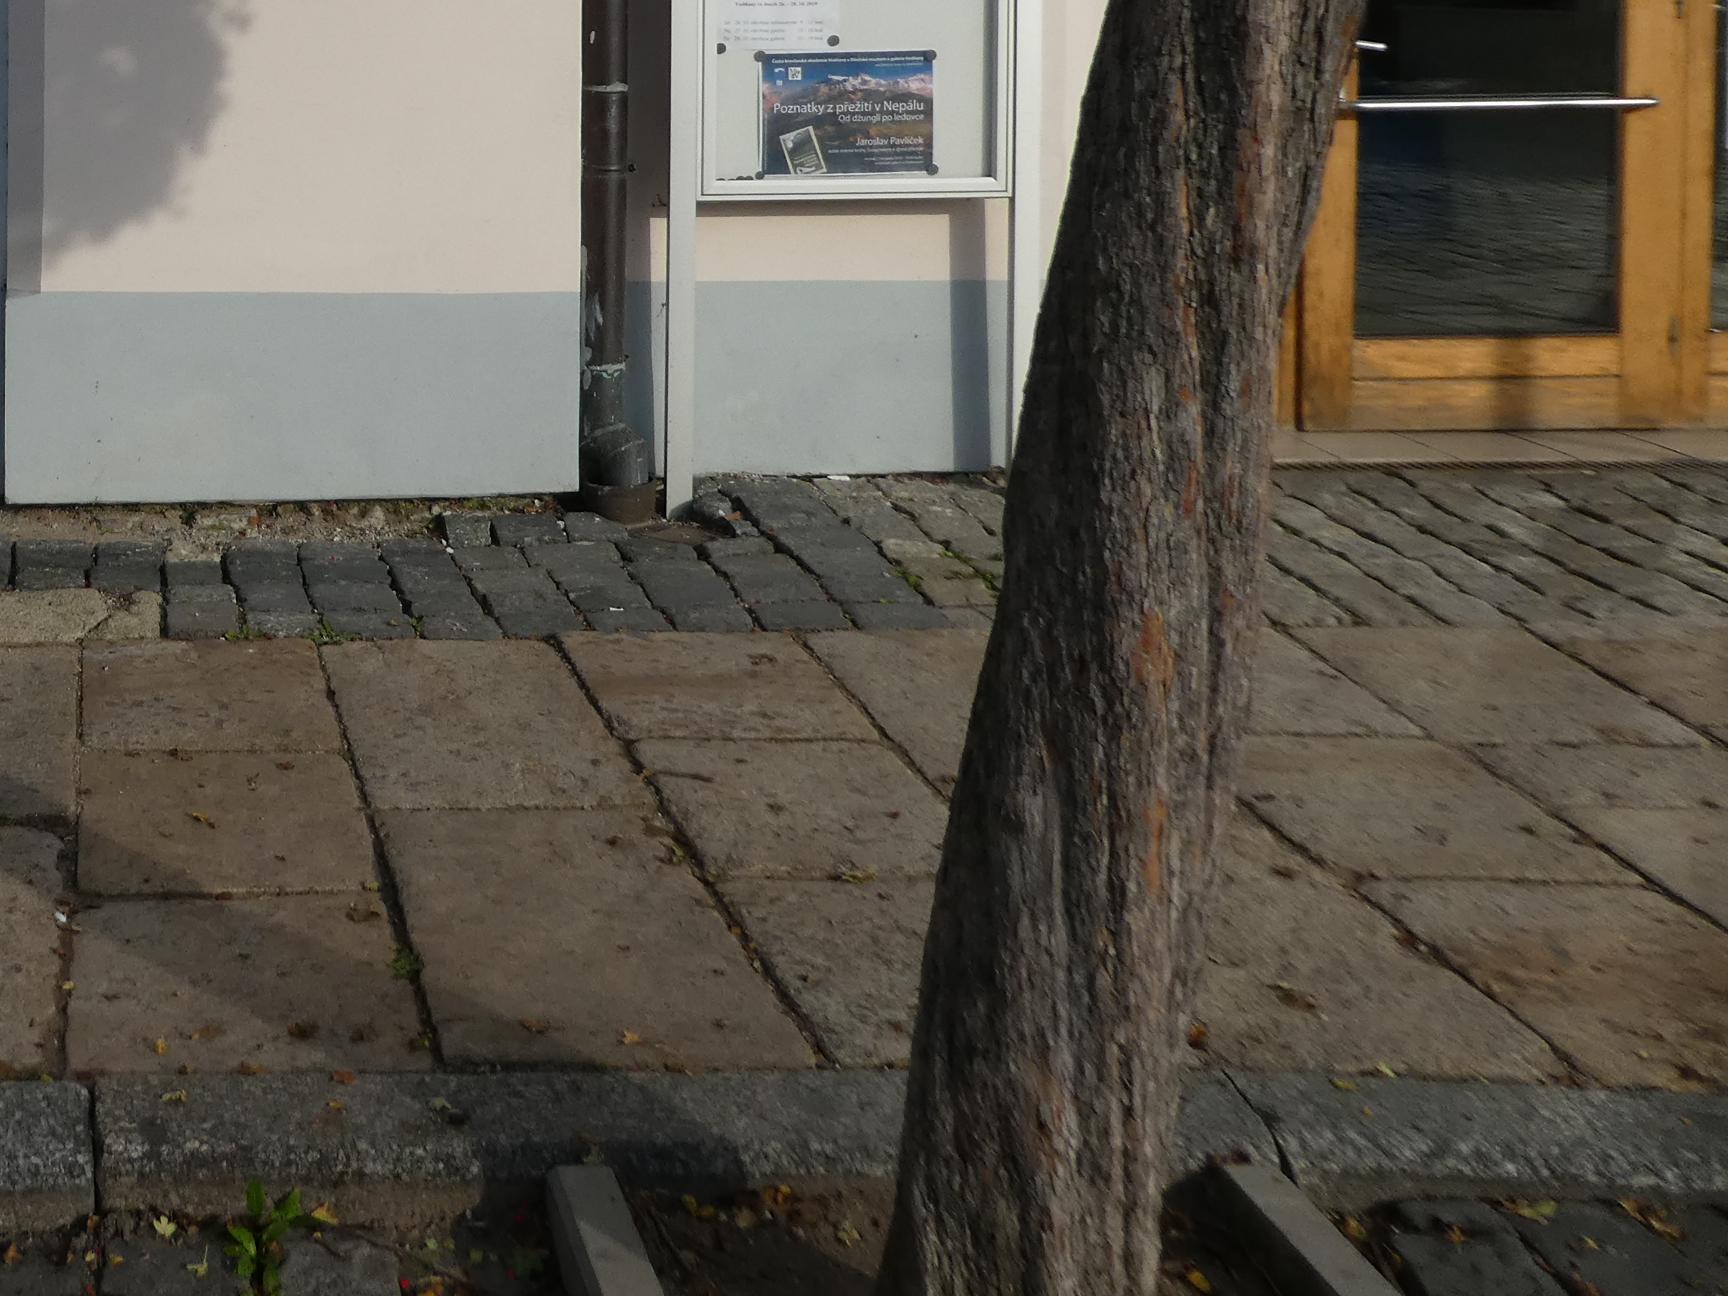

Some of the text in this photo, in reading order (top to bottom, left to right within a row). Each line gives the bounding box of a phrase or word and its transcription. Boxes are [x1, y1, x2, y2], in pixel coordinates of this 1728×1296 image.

[773, 100, 924, 115] Poznatky z přežití v Nepálu
[838, 114, 851, 122] Od
[882, 115, 893, 123] po
[855, 136, 924, 147] Jaroslav Pavlíček
